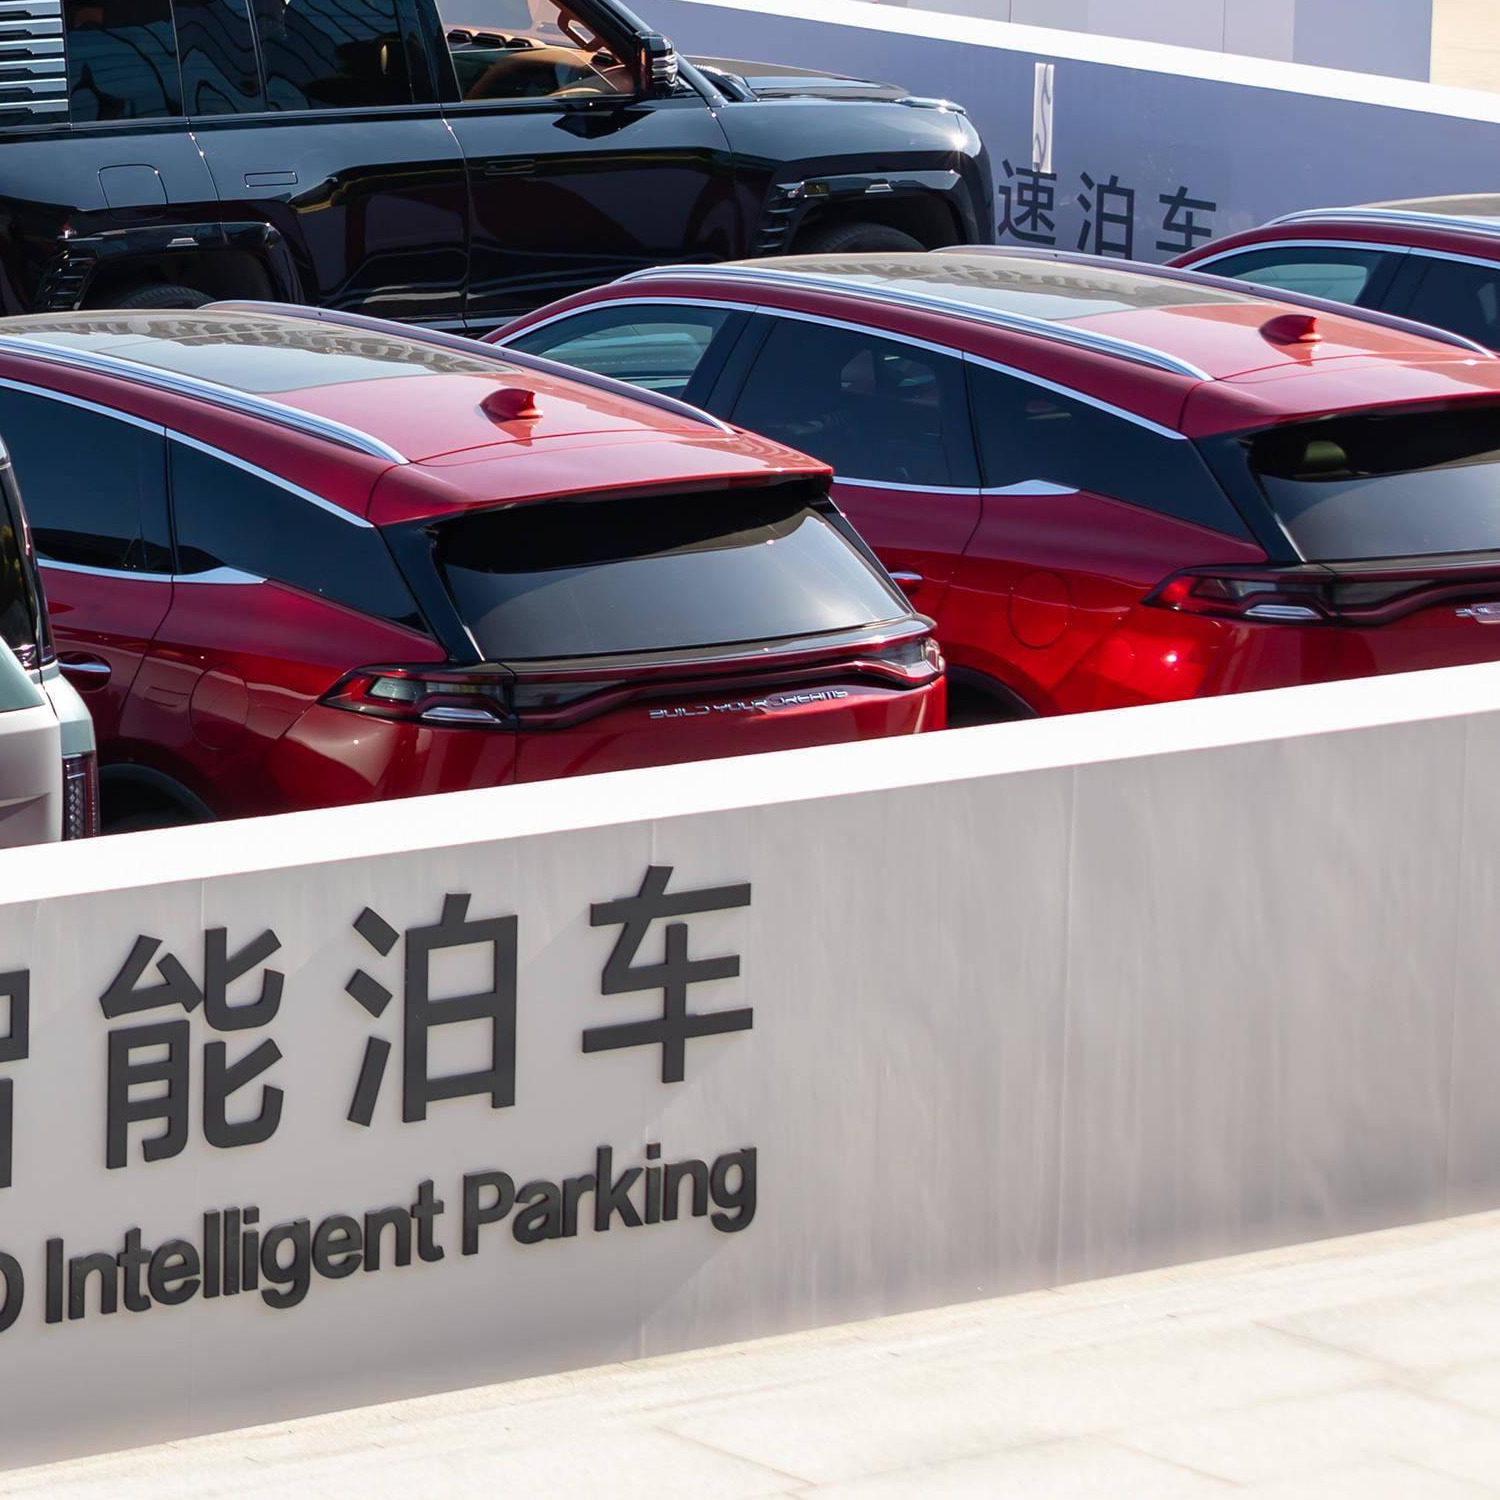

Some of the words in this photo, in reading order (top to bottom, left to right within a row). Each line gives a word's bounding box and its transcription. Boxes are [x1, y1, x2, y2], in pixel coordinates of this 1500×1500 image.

[997, 158, 1217, 262] 速泊车
[45, 1179, 446, 1325] Intelligent
[461, 1142, 758, 1257] Parking
